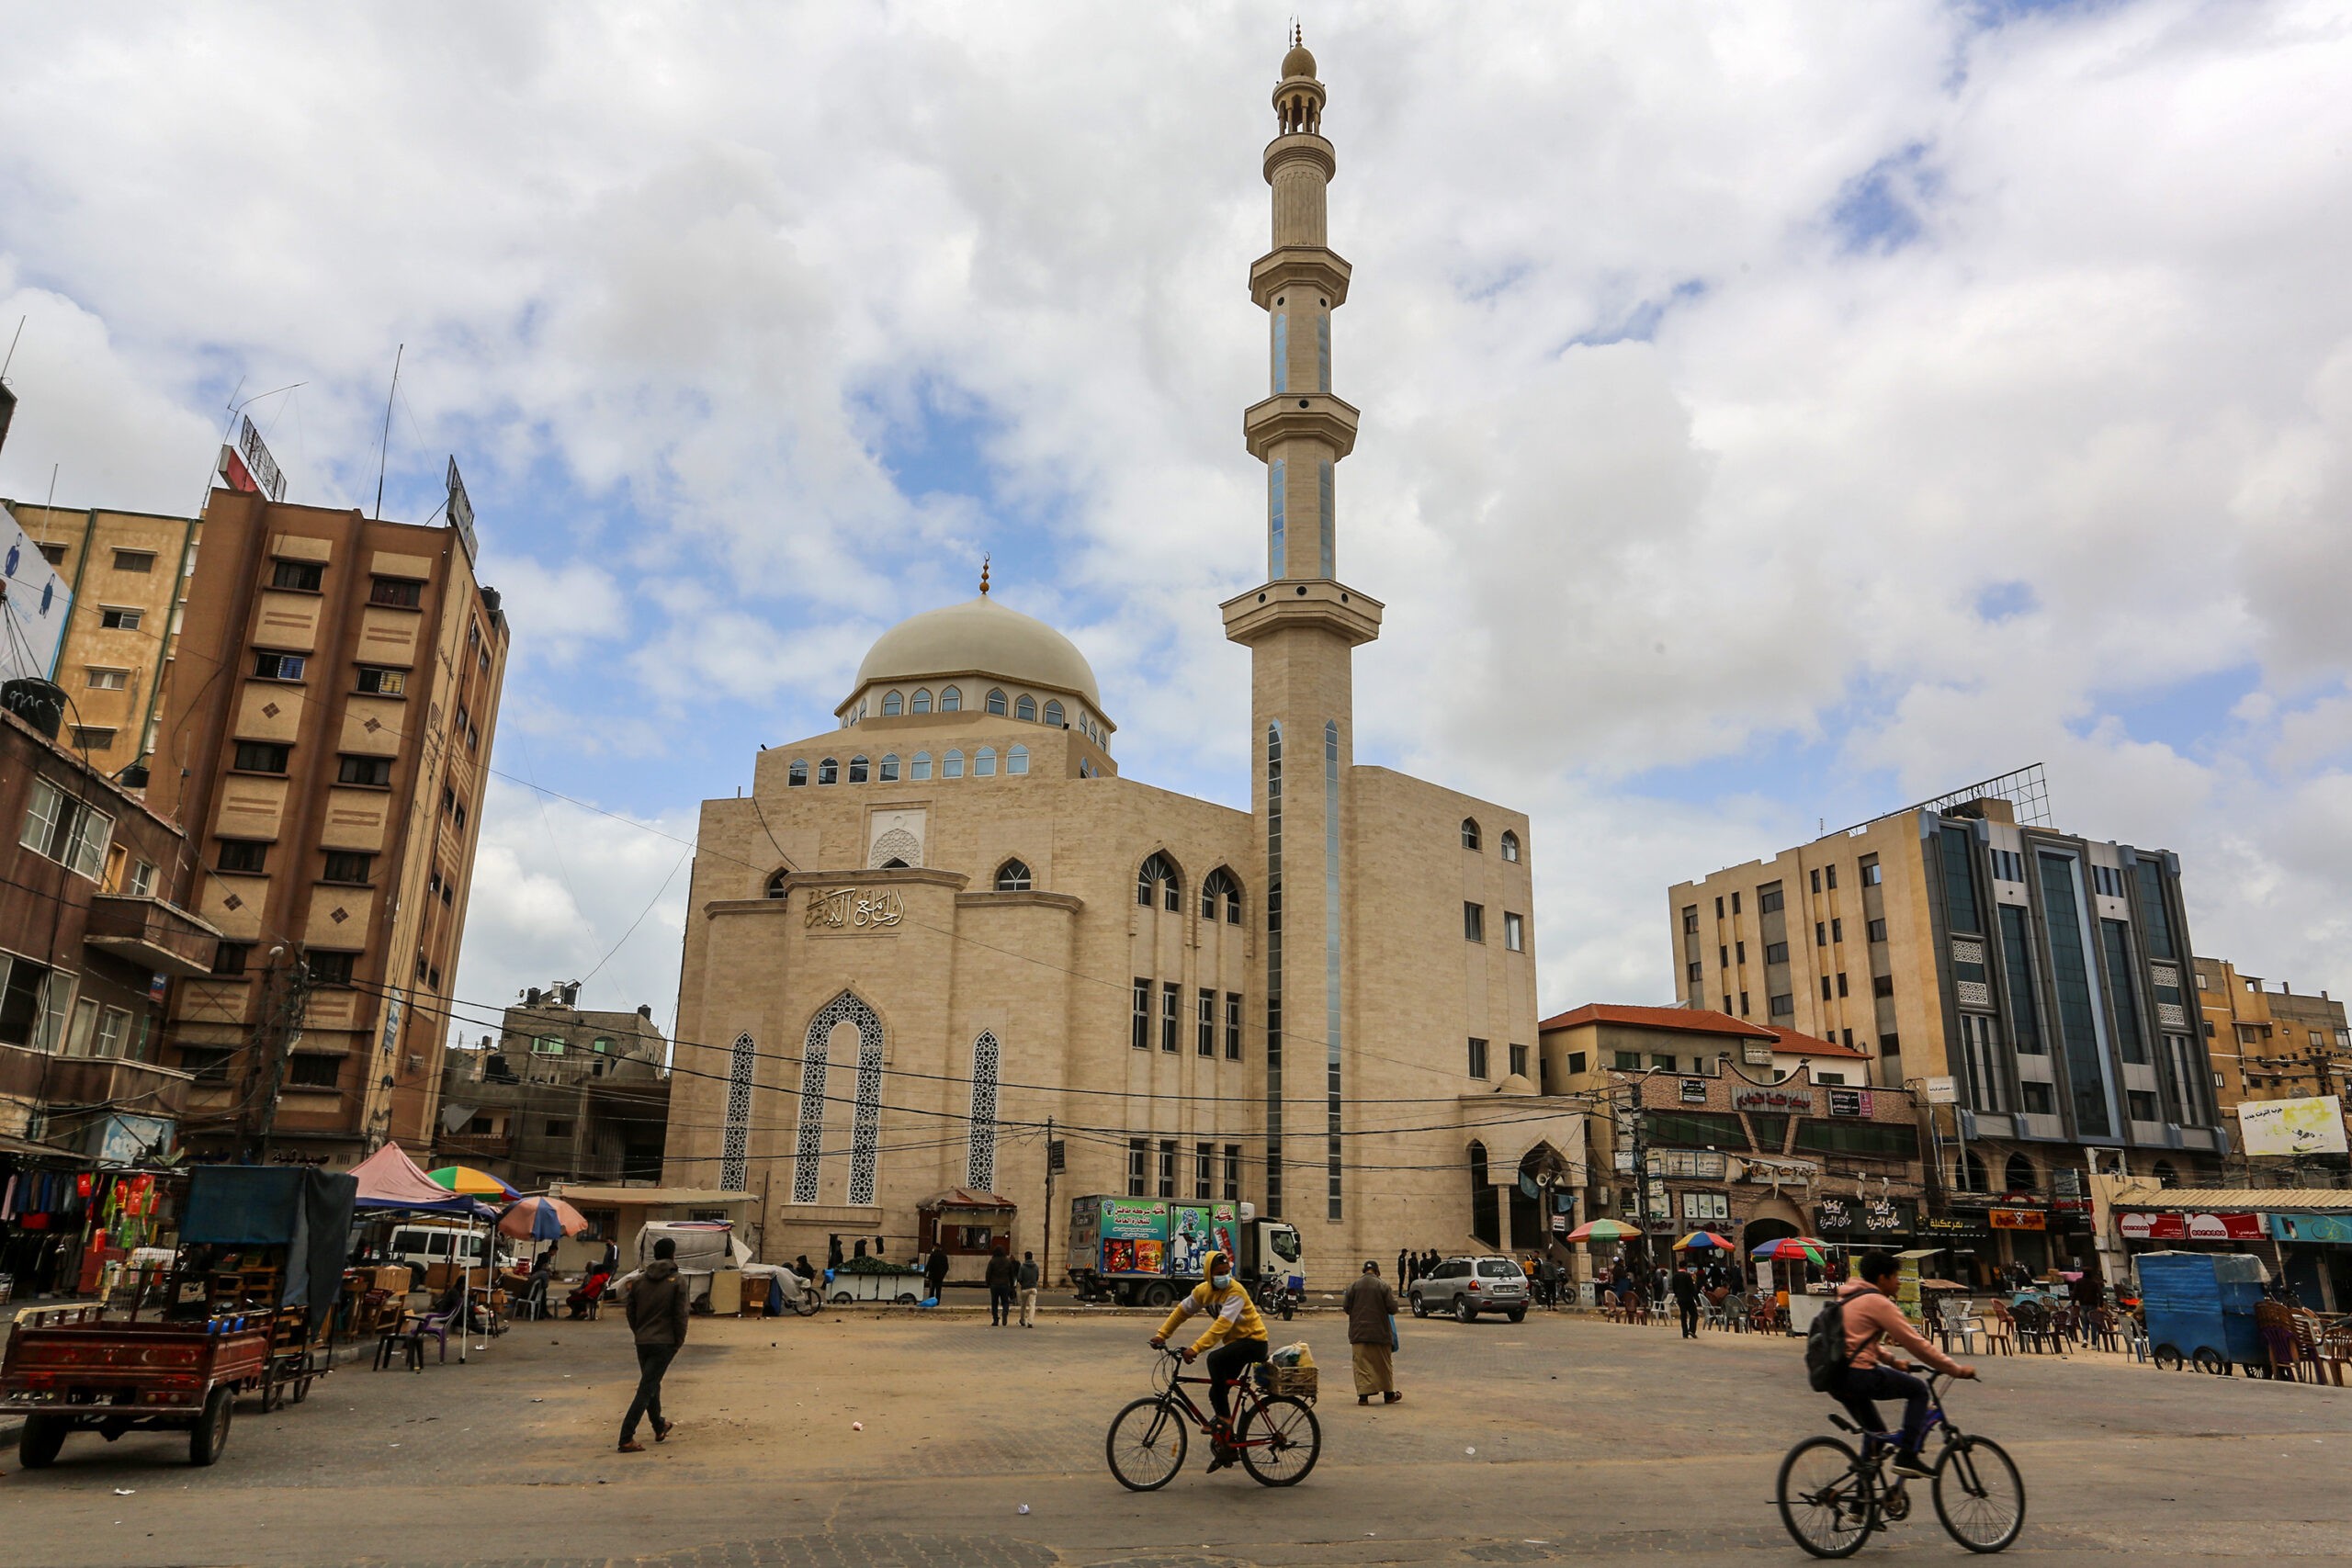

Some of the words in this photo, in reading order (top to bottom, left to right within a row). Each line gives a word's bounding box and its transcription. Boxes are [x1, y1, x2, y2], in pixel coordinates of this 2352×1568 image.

[805, 887, 856, 929] الكبير
[854, 888, 905, 930] الجامع
[1114, 1216, 1132, 1224] العامة
[1132, 1206, 1150, 1215] شركة
